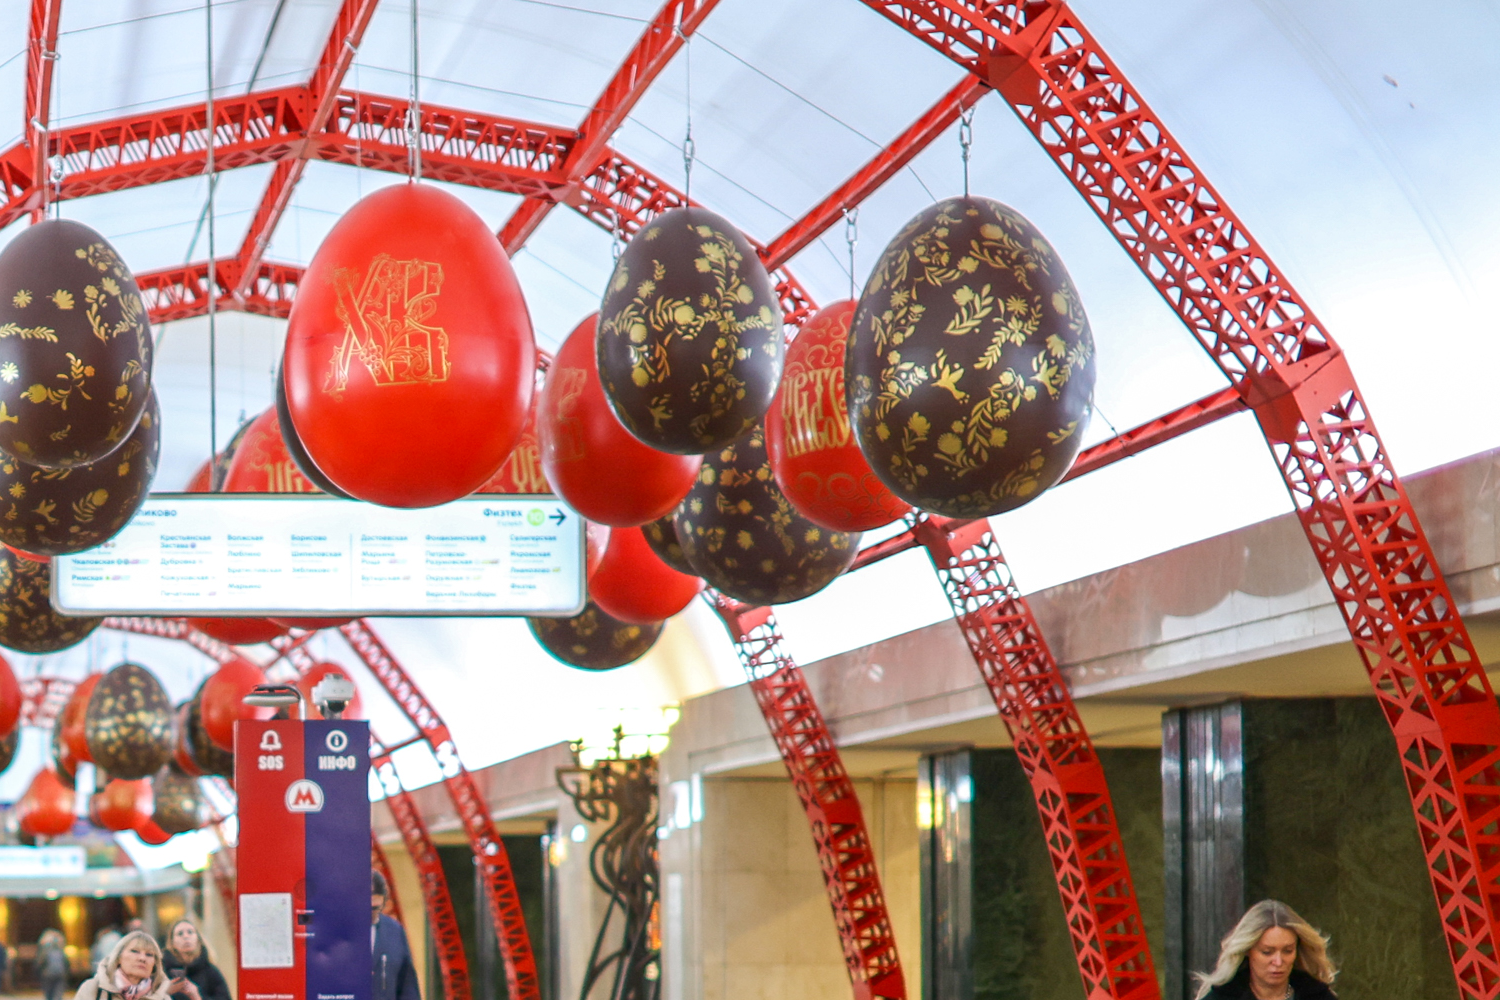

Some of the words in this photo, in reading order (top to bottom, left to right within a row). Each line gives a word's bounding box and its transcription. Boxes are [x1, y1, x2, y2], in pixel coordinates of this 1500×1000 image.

[483, 508, 523, 518] Физтех
[258, 755, 285, 771] SOS
[318, 755, 356, 771] ИНФО
